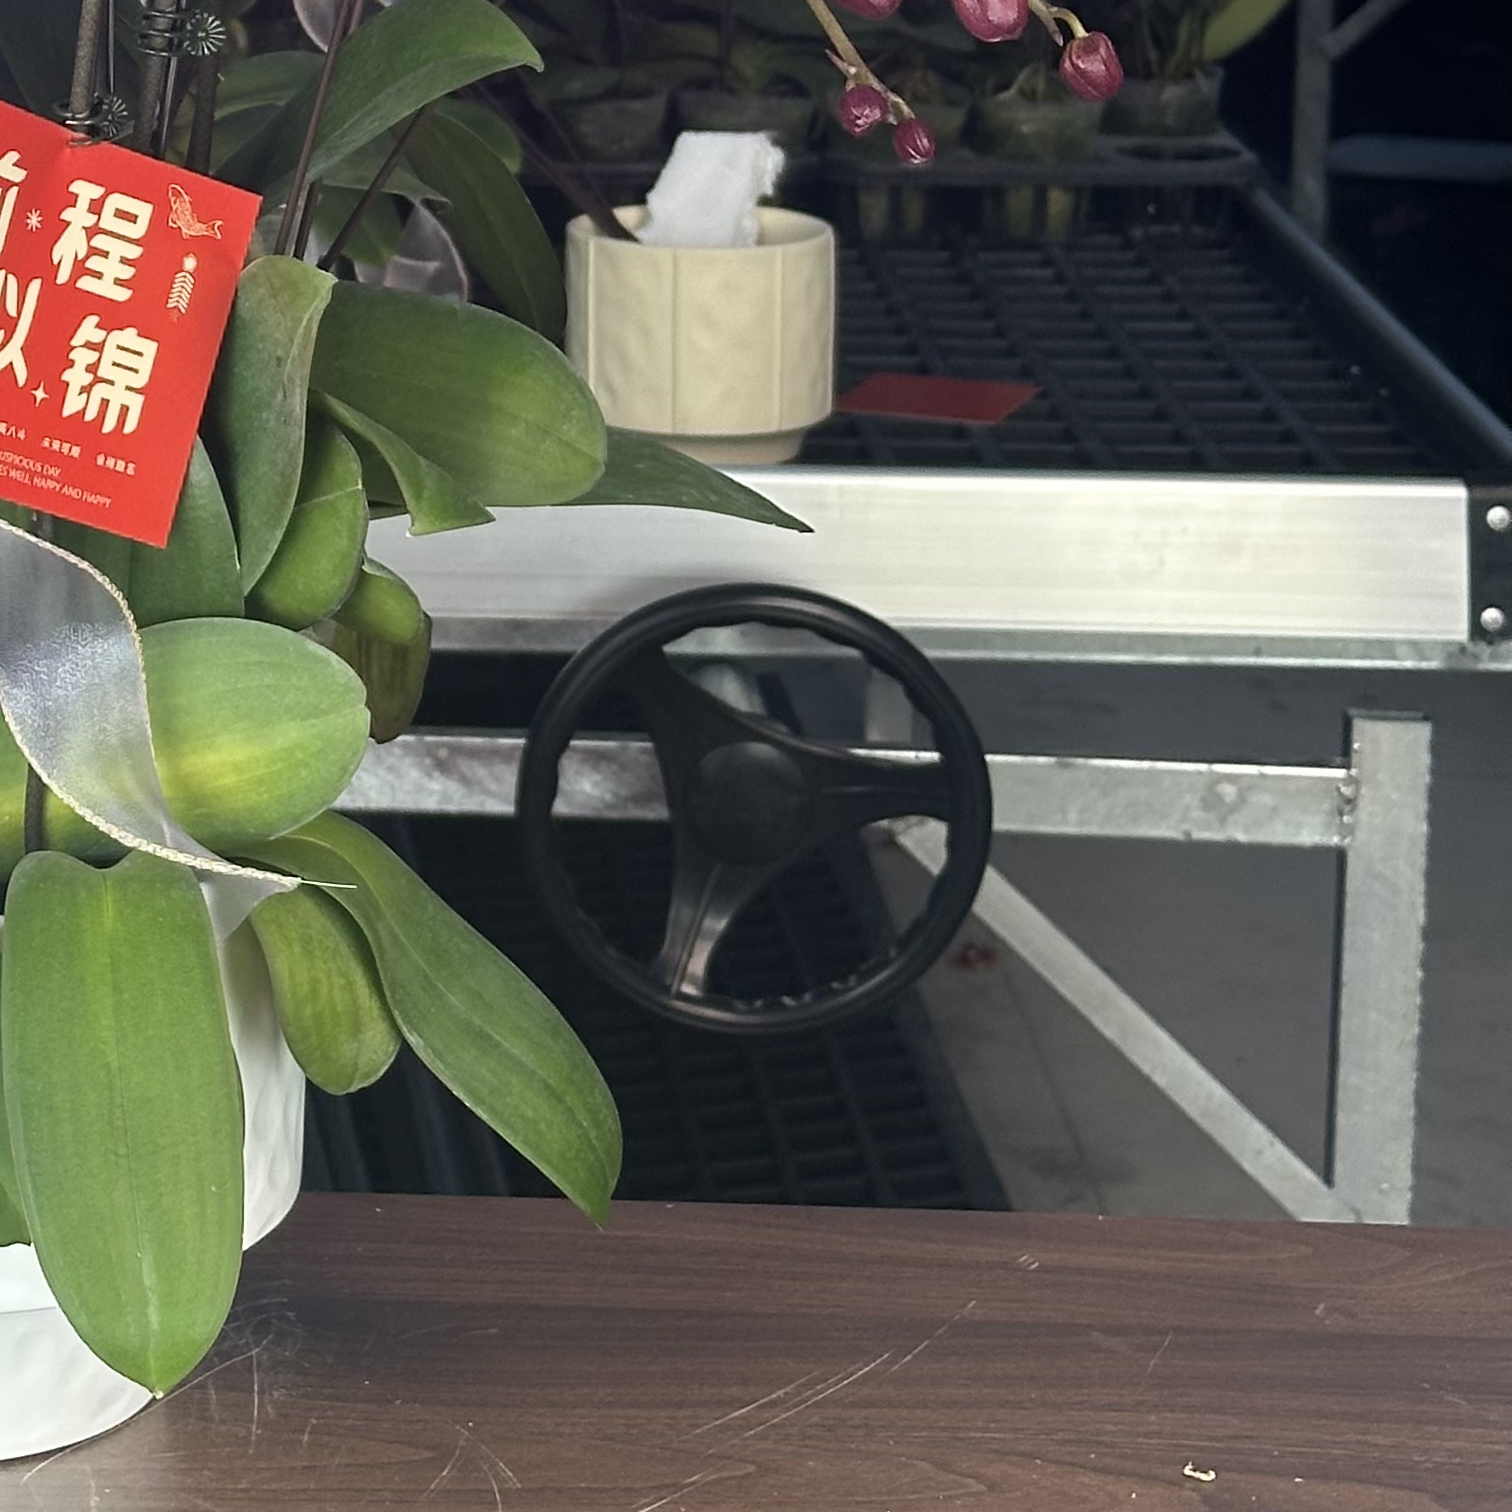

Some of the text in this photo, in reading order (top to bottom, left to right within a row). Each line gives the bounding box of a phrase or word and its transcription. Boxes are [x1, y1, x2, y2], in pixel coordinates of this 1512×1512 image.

[42, 463, 62, 478] DAY
[31, 474, 62, 493] HAPPY
[60, 484, 82, 499] AND
[82, 490, 111, 508] HAPPY
